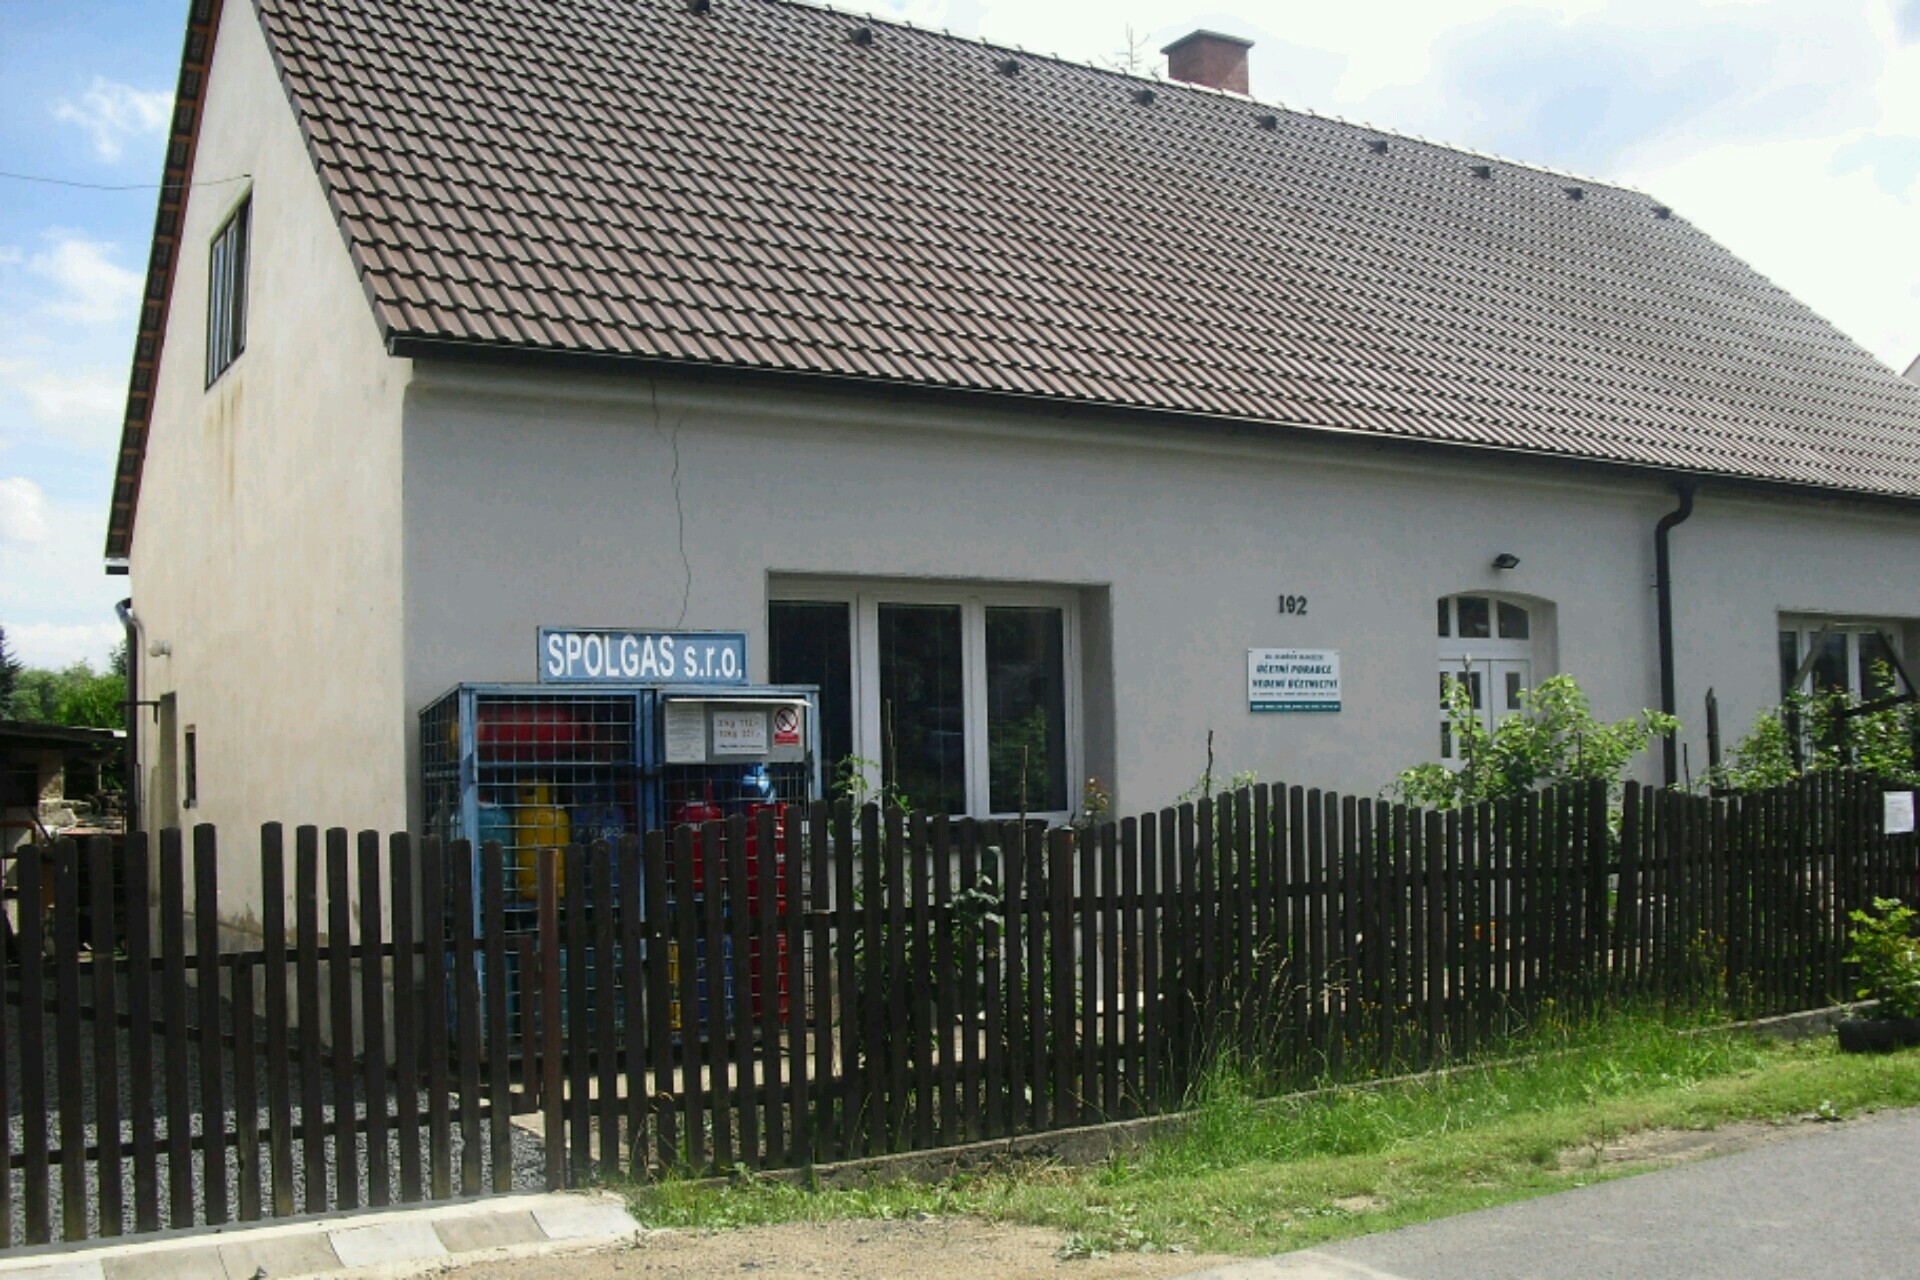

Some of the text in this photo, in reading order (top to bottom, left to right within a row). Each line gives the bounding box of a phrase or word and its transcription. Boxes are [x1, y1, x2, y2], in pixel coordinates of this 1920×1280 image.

[1278, 594, 1308, 616] 192
[548, 633, 742, 678] SPOLGAS s.r.o.
